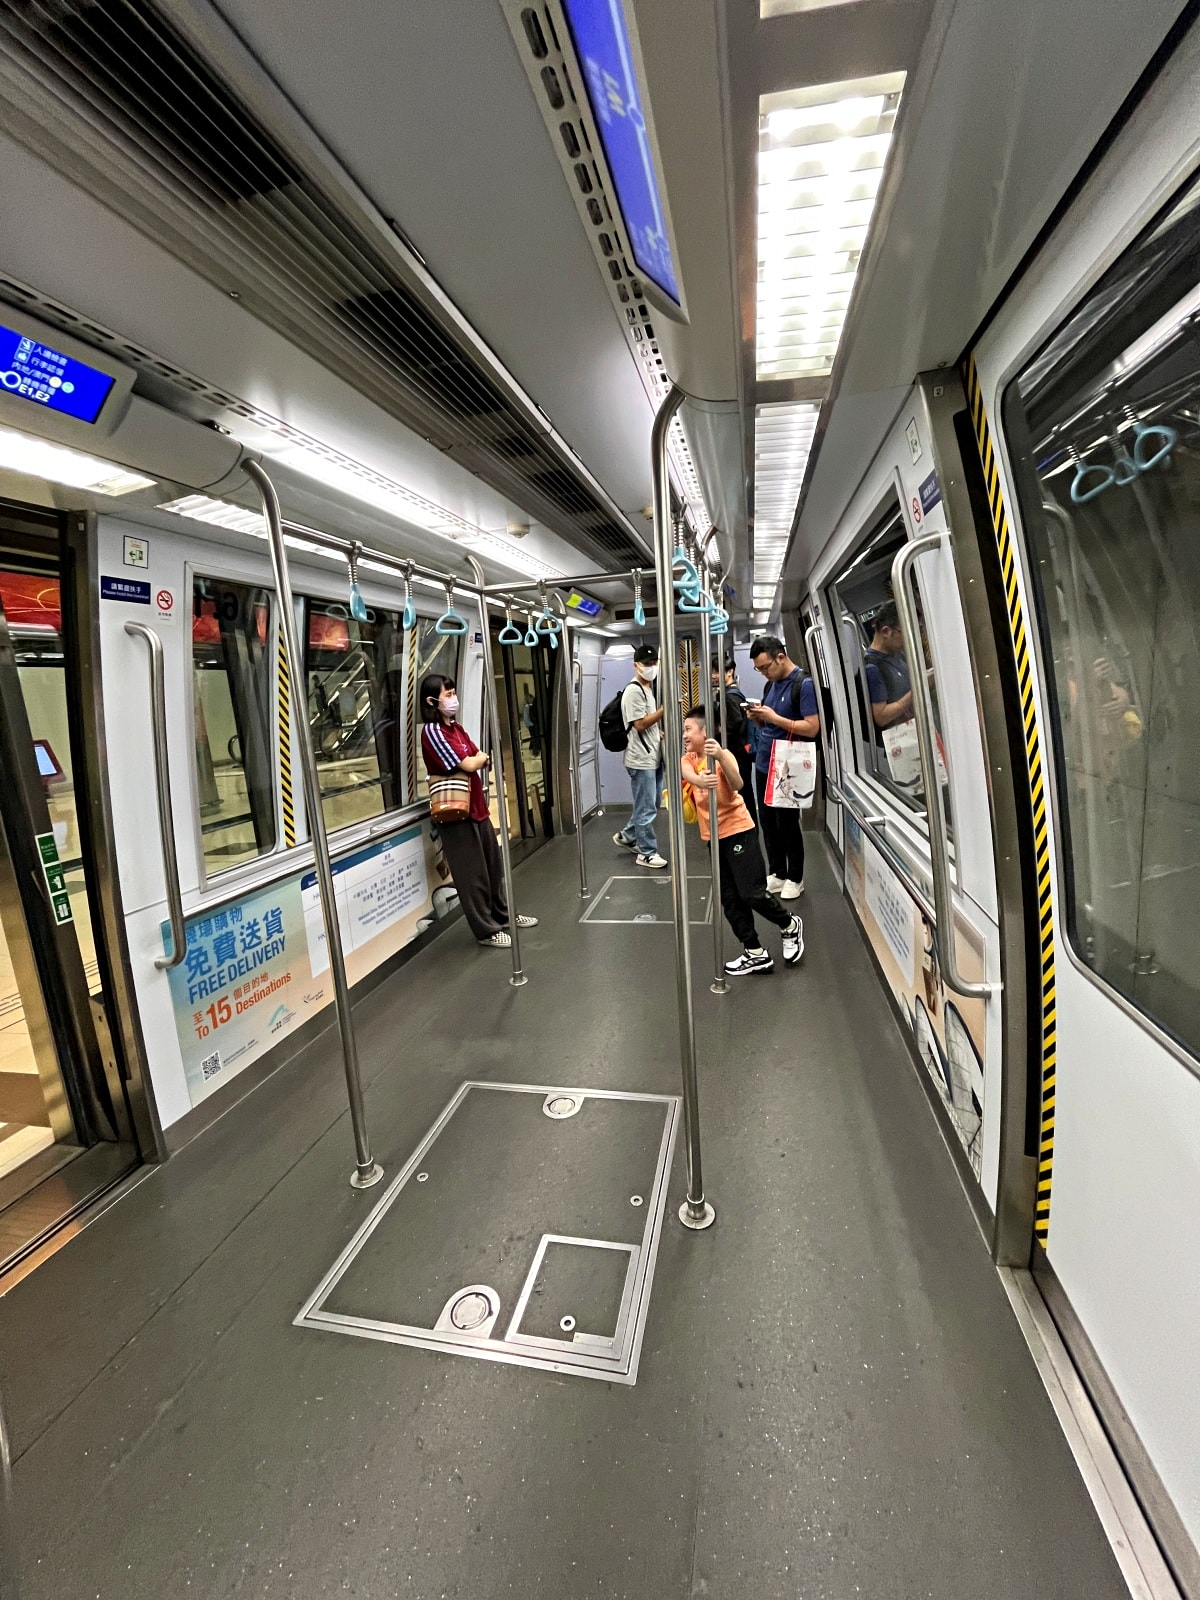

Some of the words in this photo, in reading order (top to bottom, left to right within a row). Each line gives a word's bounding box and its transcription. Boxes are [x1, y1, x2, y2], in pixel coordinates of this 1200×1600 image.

[184, 907, 284, 984] 免費送貨
[188, 968, 226, 1004] FREE
[228, 936, 286, 982] DELIVERY
[192, 1010, 204, 1026] 至
[206, 995, 232, 1030] 15
[194, 1025, 210, 1040] To
[235, 973, 292, 1015] Destinations
